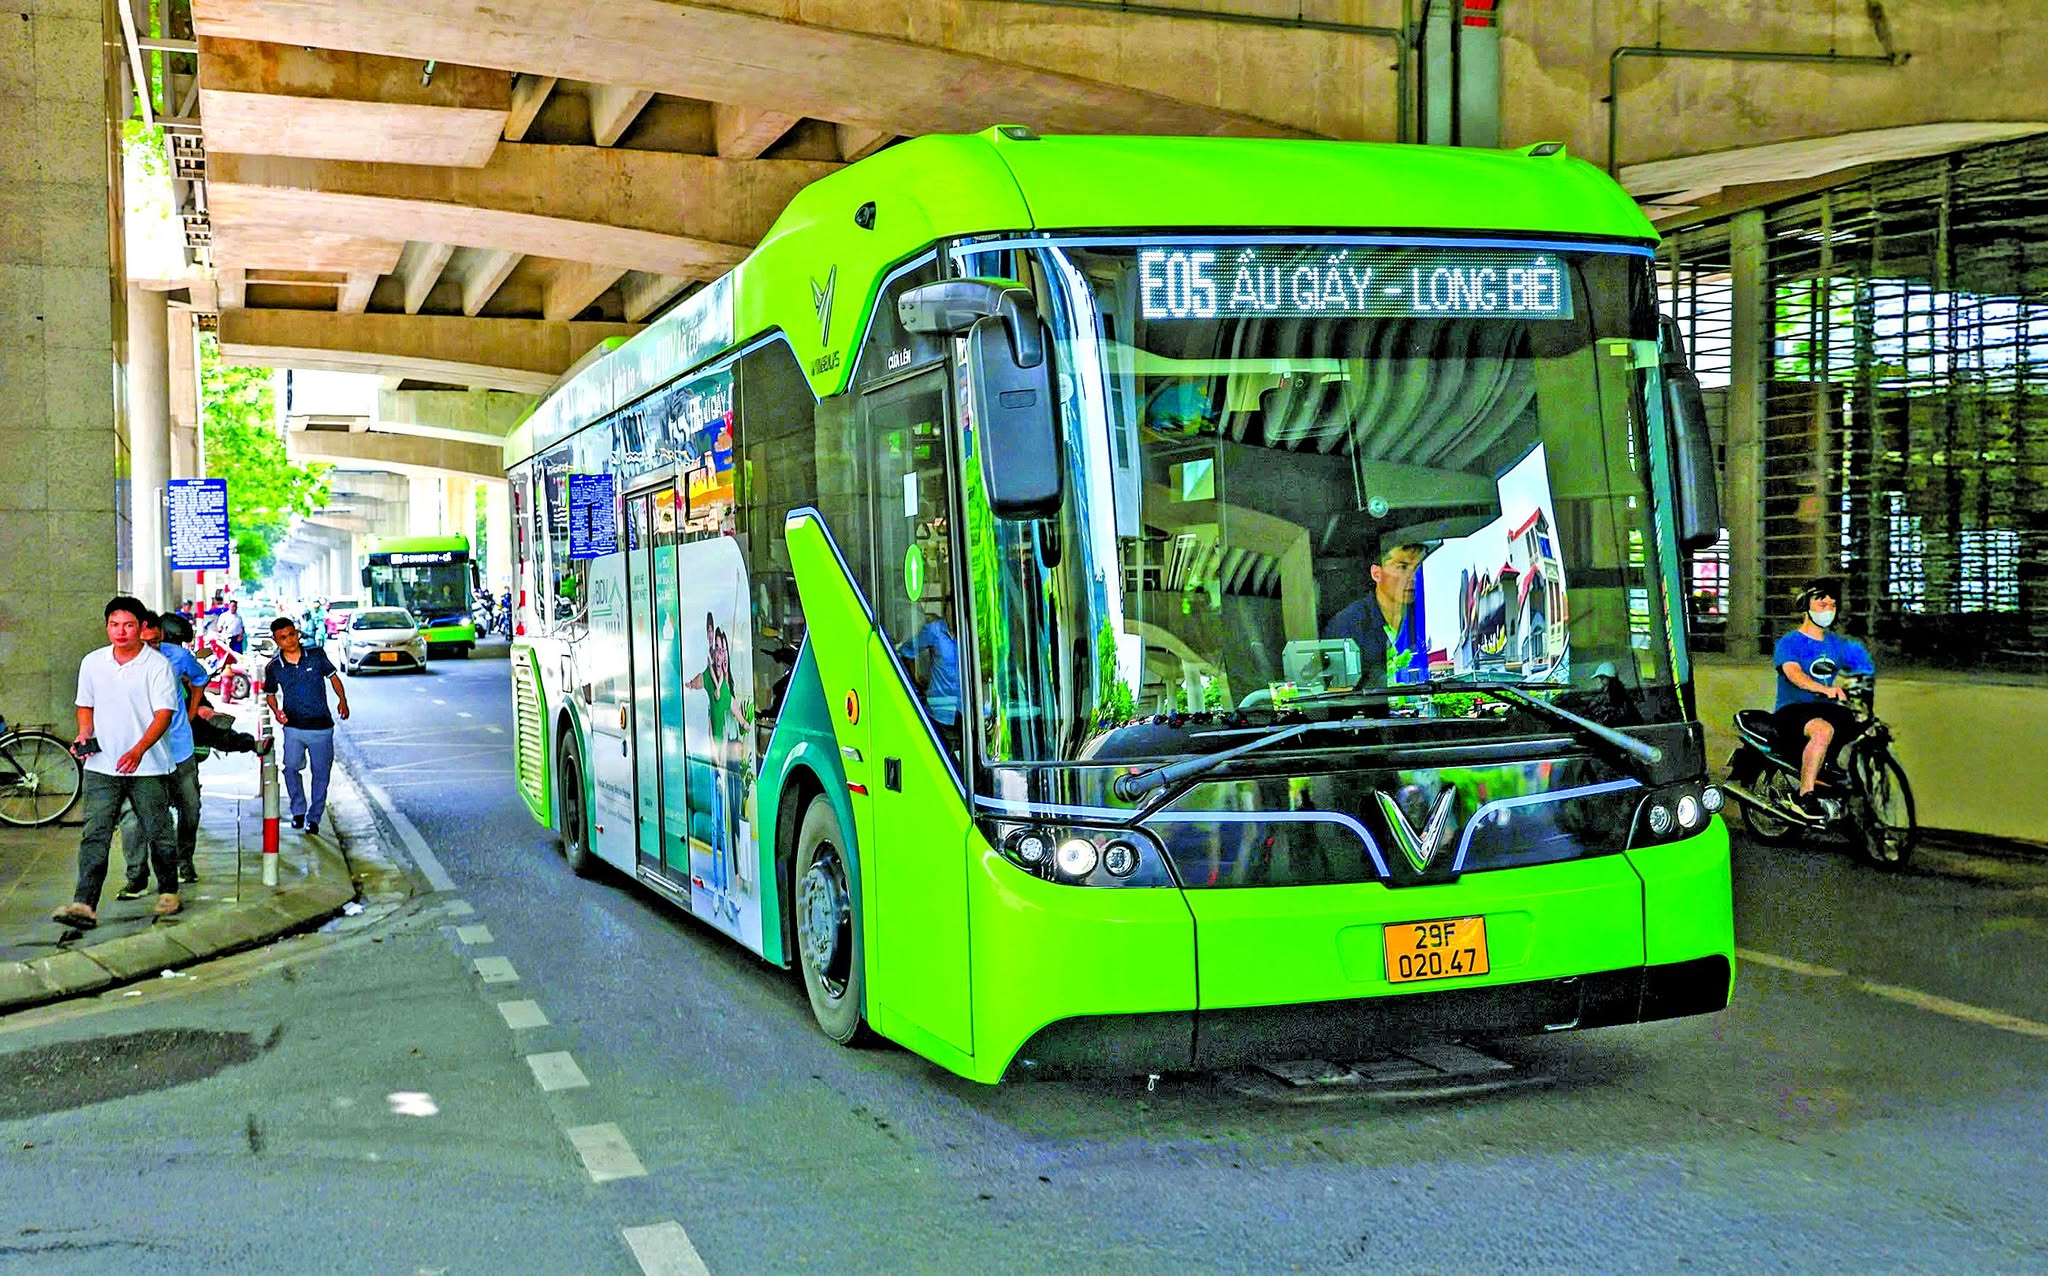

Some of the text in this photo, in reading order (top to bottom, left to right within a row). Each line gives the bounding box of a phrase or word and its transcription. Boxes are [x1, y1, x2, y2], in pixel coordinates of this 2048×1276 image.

[1141, 251, 1216, 318] E05
[1292, 249, 1372, 310] GIẤY
[1412, 267, 1498, 310] LONG
[1415, 922, 1456, 949] 29F
[1399, 948, 1476, 978] 020.47
